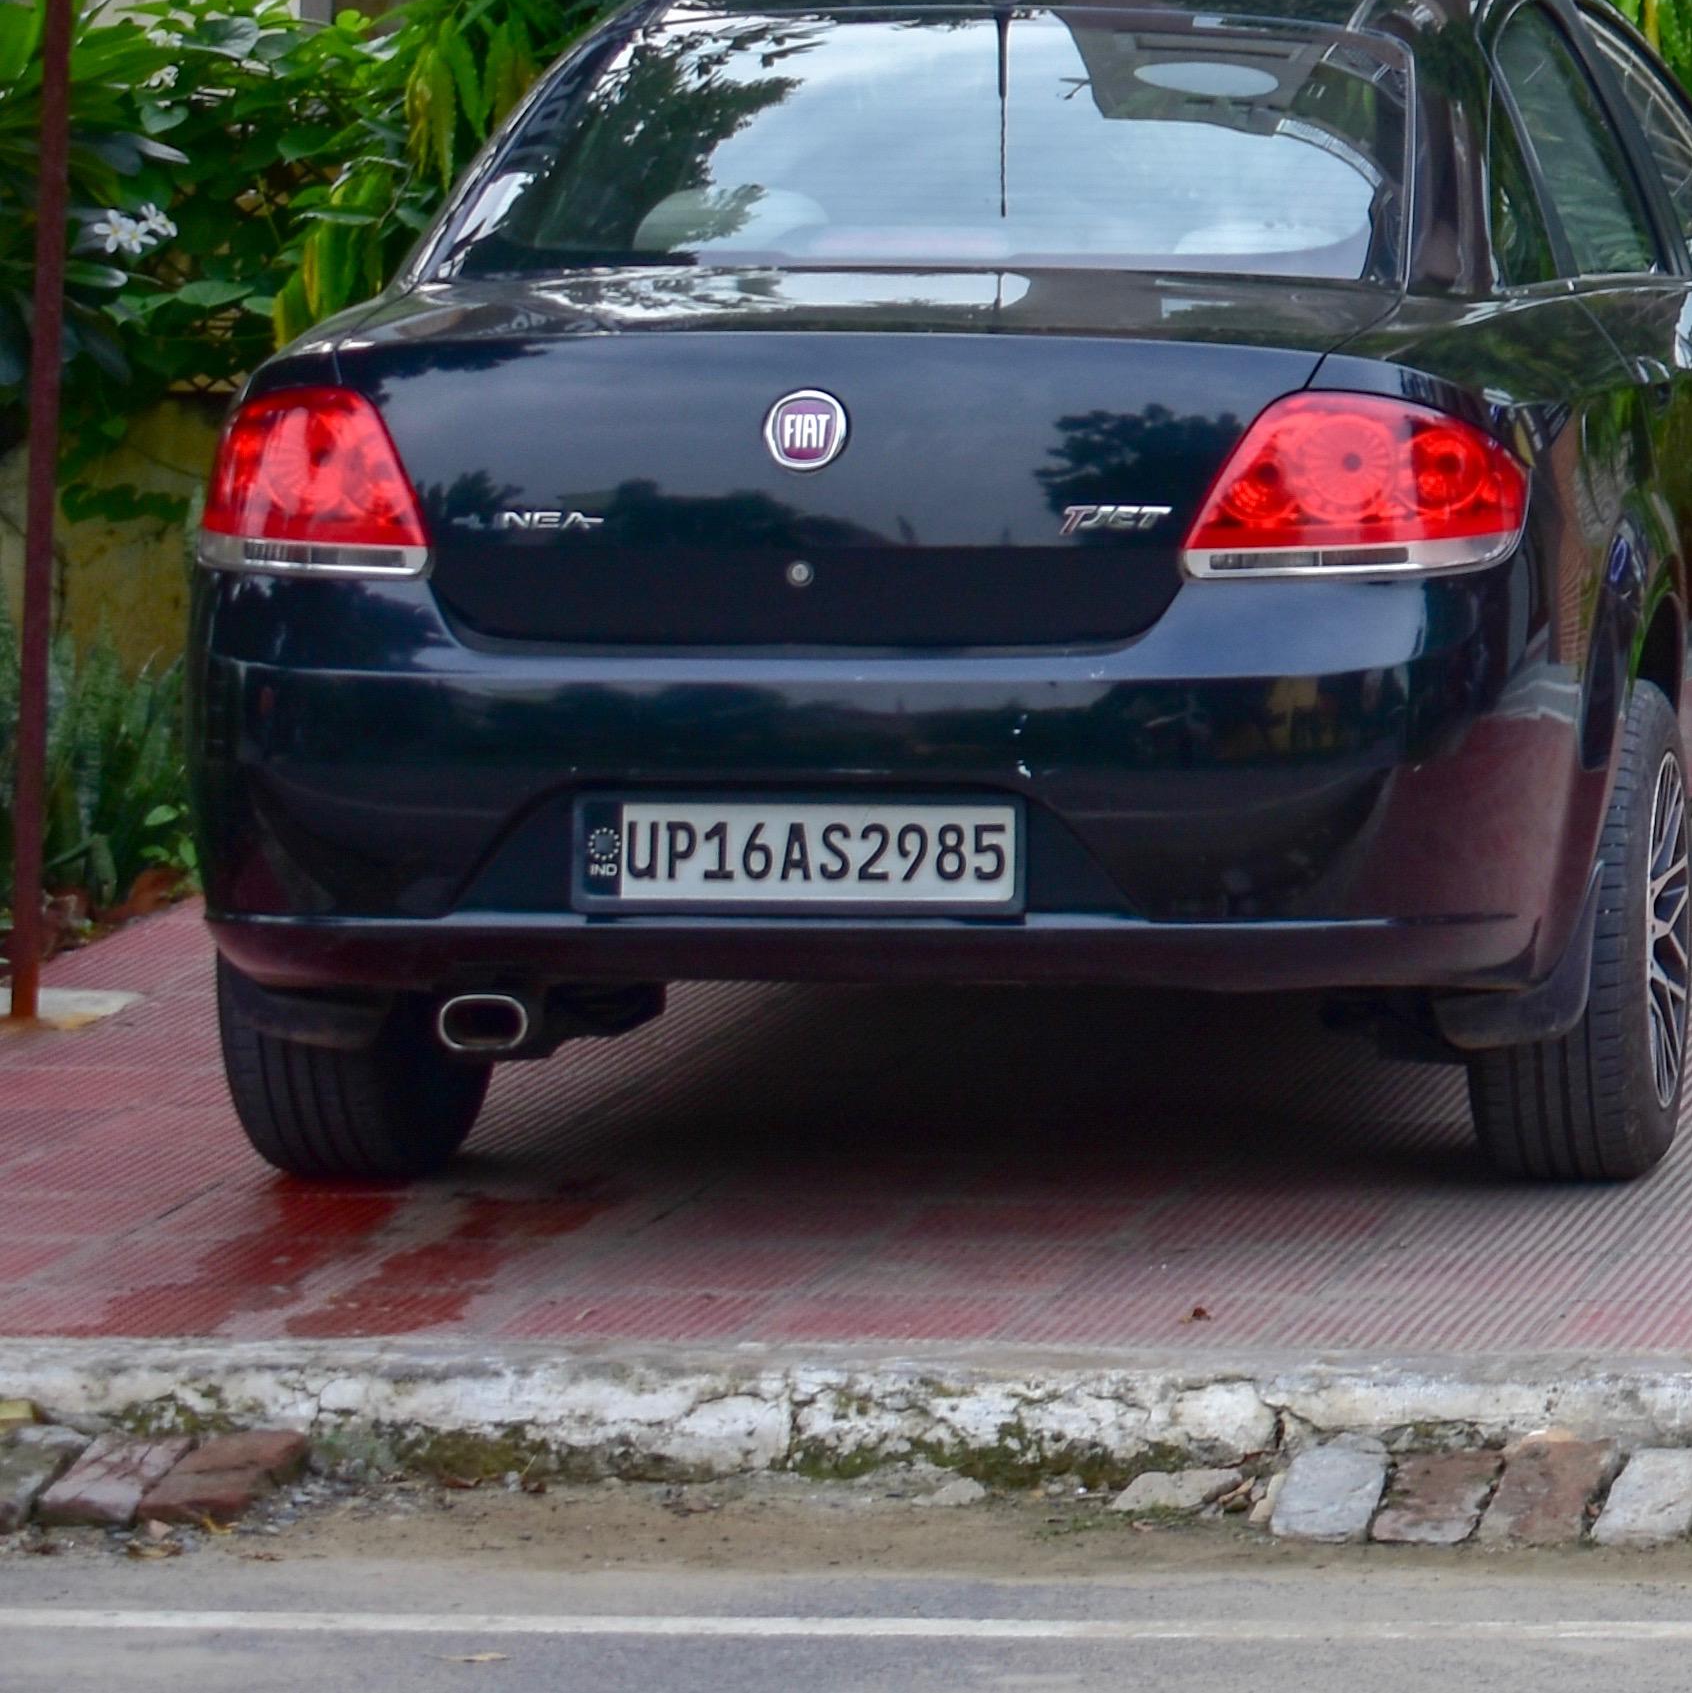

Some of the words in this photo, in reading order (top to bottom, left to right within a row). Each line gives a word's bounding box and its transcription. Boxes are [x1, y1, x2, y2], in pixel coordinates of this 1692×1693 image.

[784, 413, 831, 449] FIAT
[627, 820, 1007, 882] UP16AS2985
[590, 865, 618, 877] IND
